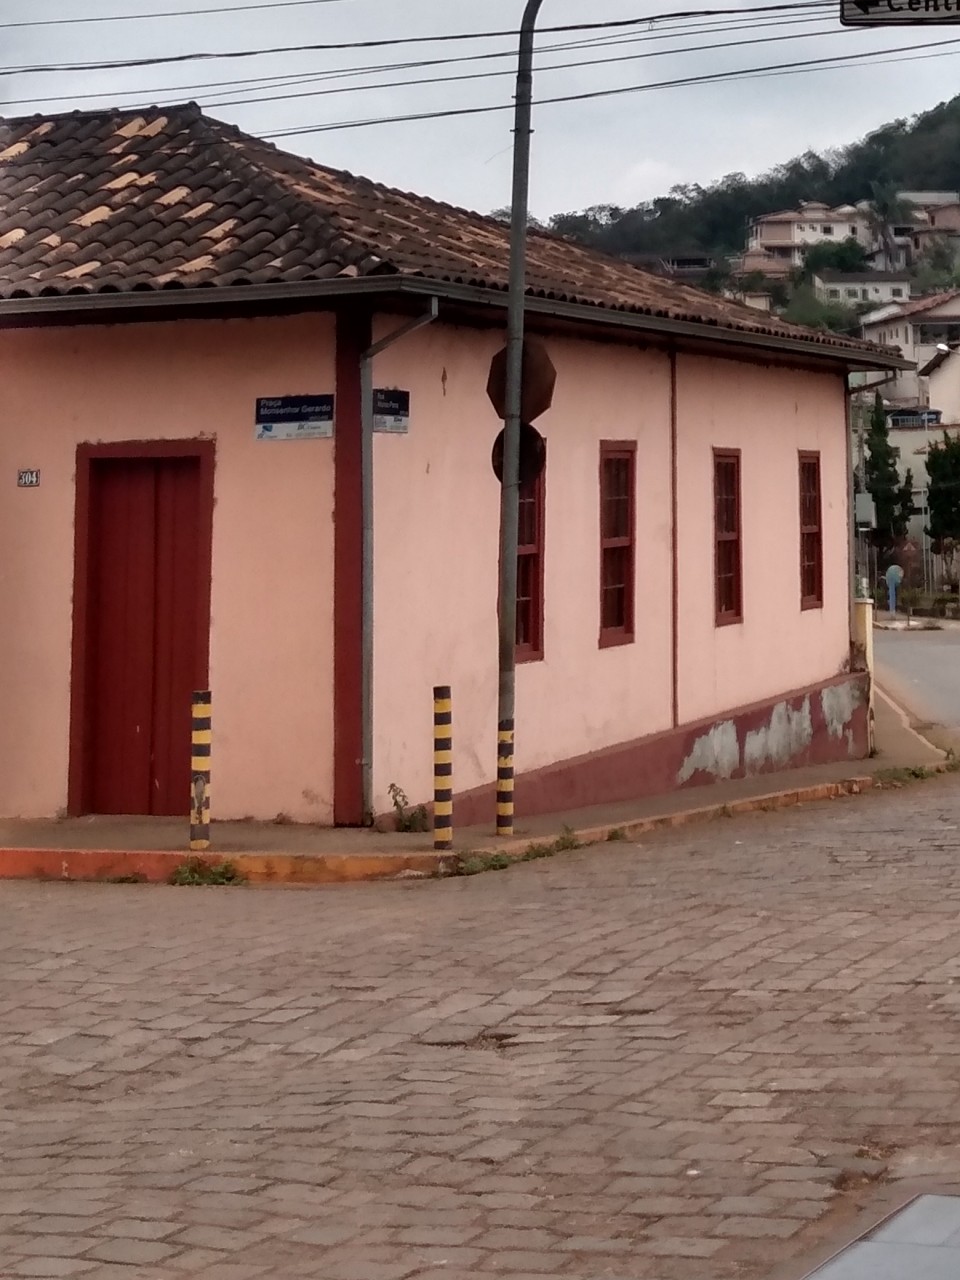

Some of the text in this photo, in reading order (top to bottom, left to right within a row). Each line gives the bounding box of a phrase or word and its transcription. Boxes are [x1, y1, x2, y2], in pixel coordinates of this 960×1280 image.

[260, 400, 282, 408] Praça
[260, 404, 332, 415] Monsenhor Gerardo
[19, 471, 37, 485] 304
